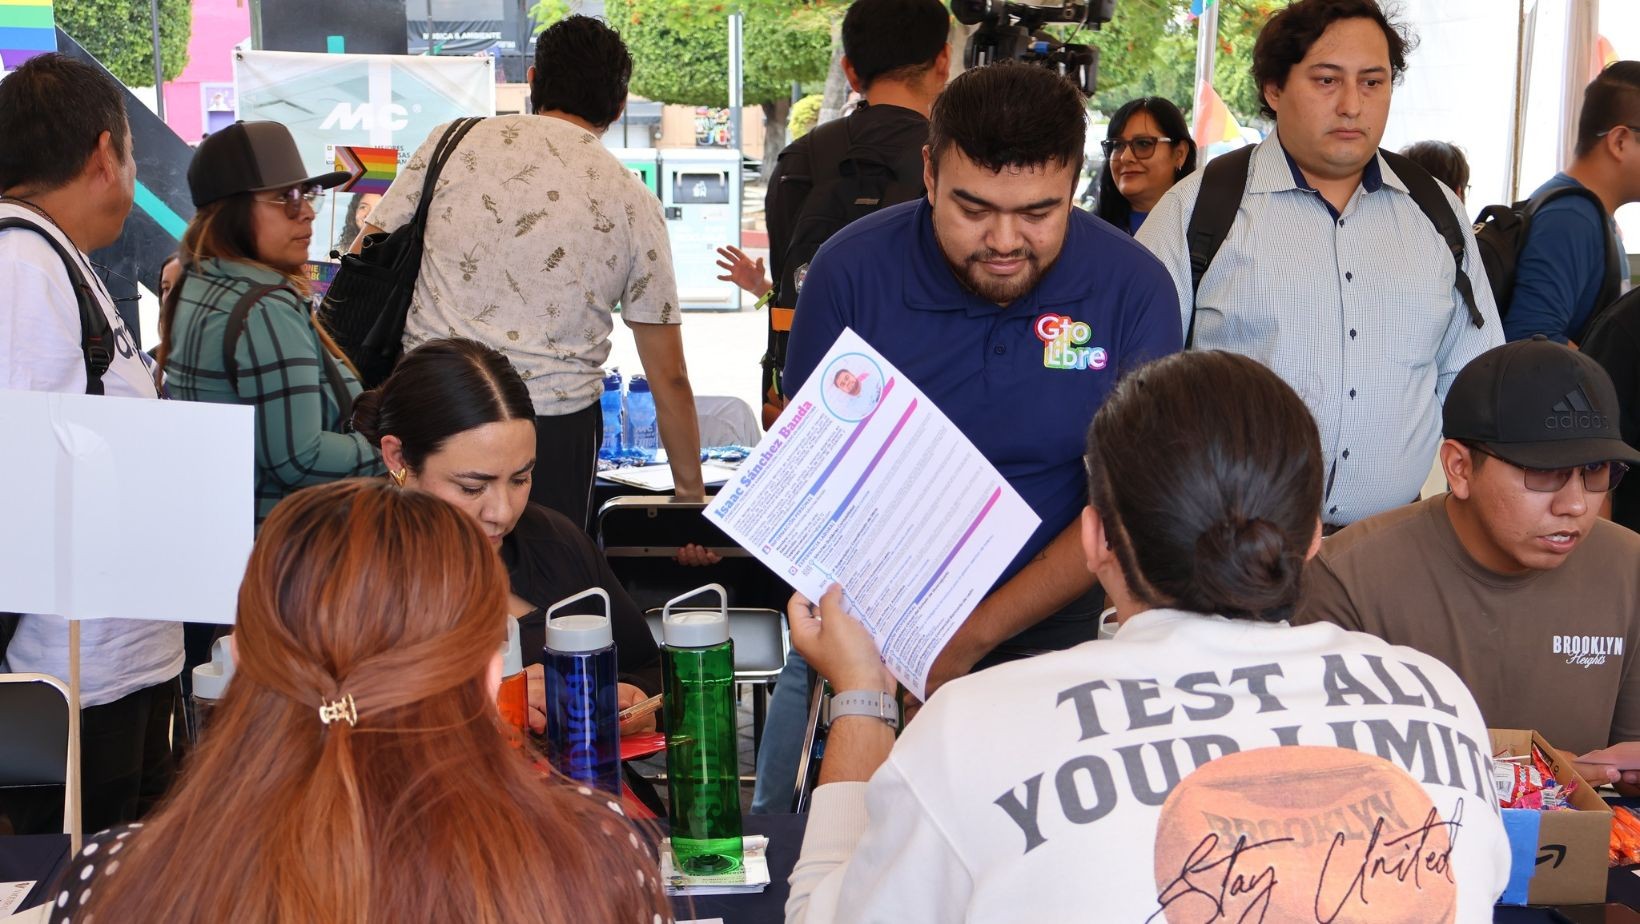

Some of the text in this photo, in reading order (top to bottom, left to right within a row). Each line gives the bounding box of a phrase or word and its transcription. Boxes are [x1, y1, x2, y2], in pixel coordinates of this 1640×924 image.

[1036, 314, 1090, 342] Gto
[1046, 341, 1106, 368] Libre
[714, 400, 813, 518] Isaac Sánchez Banda
[1553, 635, 1623, 655] BROOKLYN
[1566, 650, 1606, 668] Heights
[1056, 654, 1459, 741] TEST ALL
[1200, 790, 1409, 852] BROOKLYN
[1315, 797, 1464, 924] United
